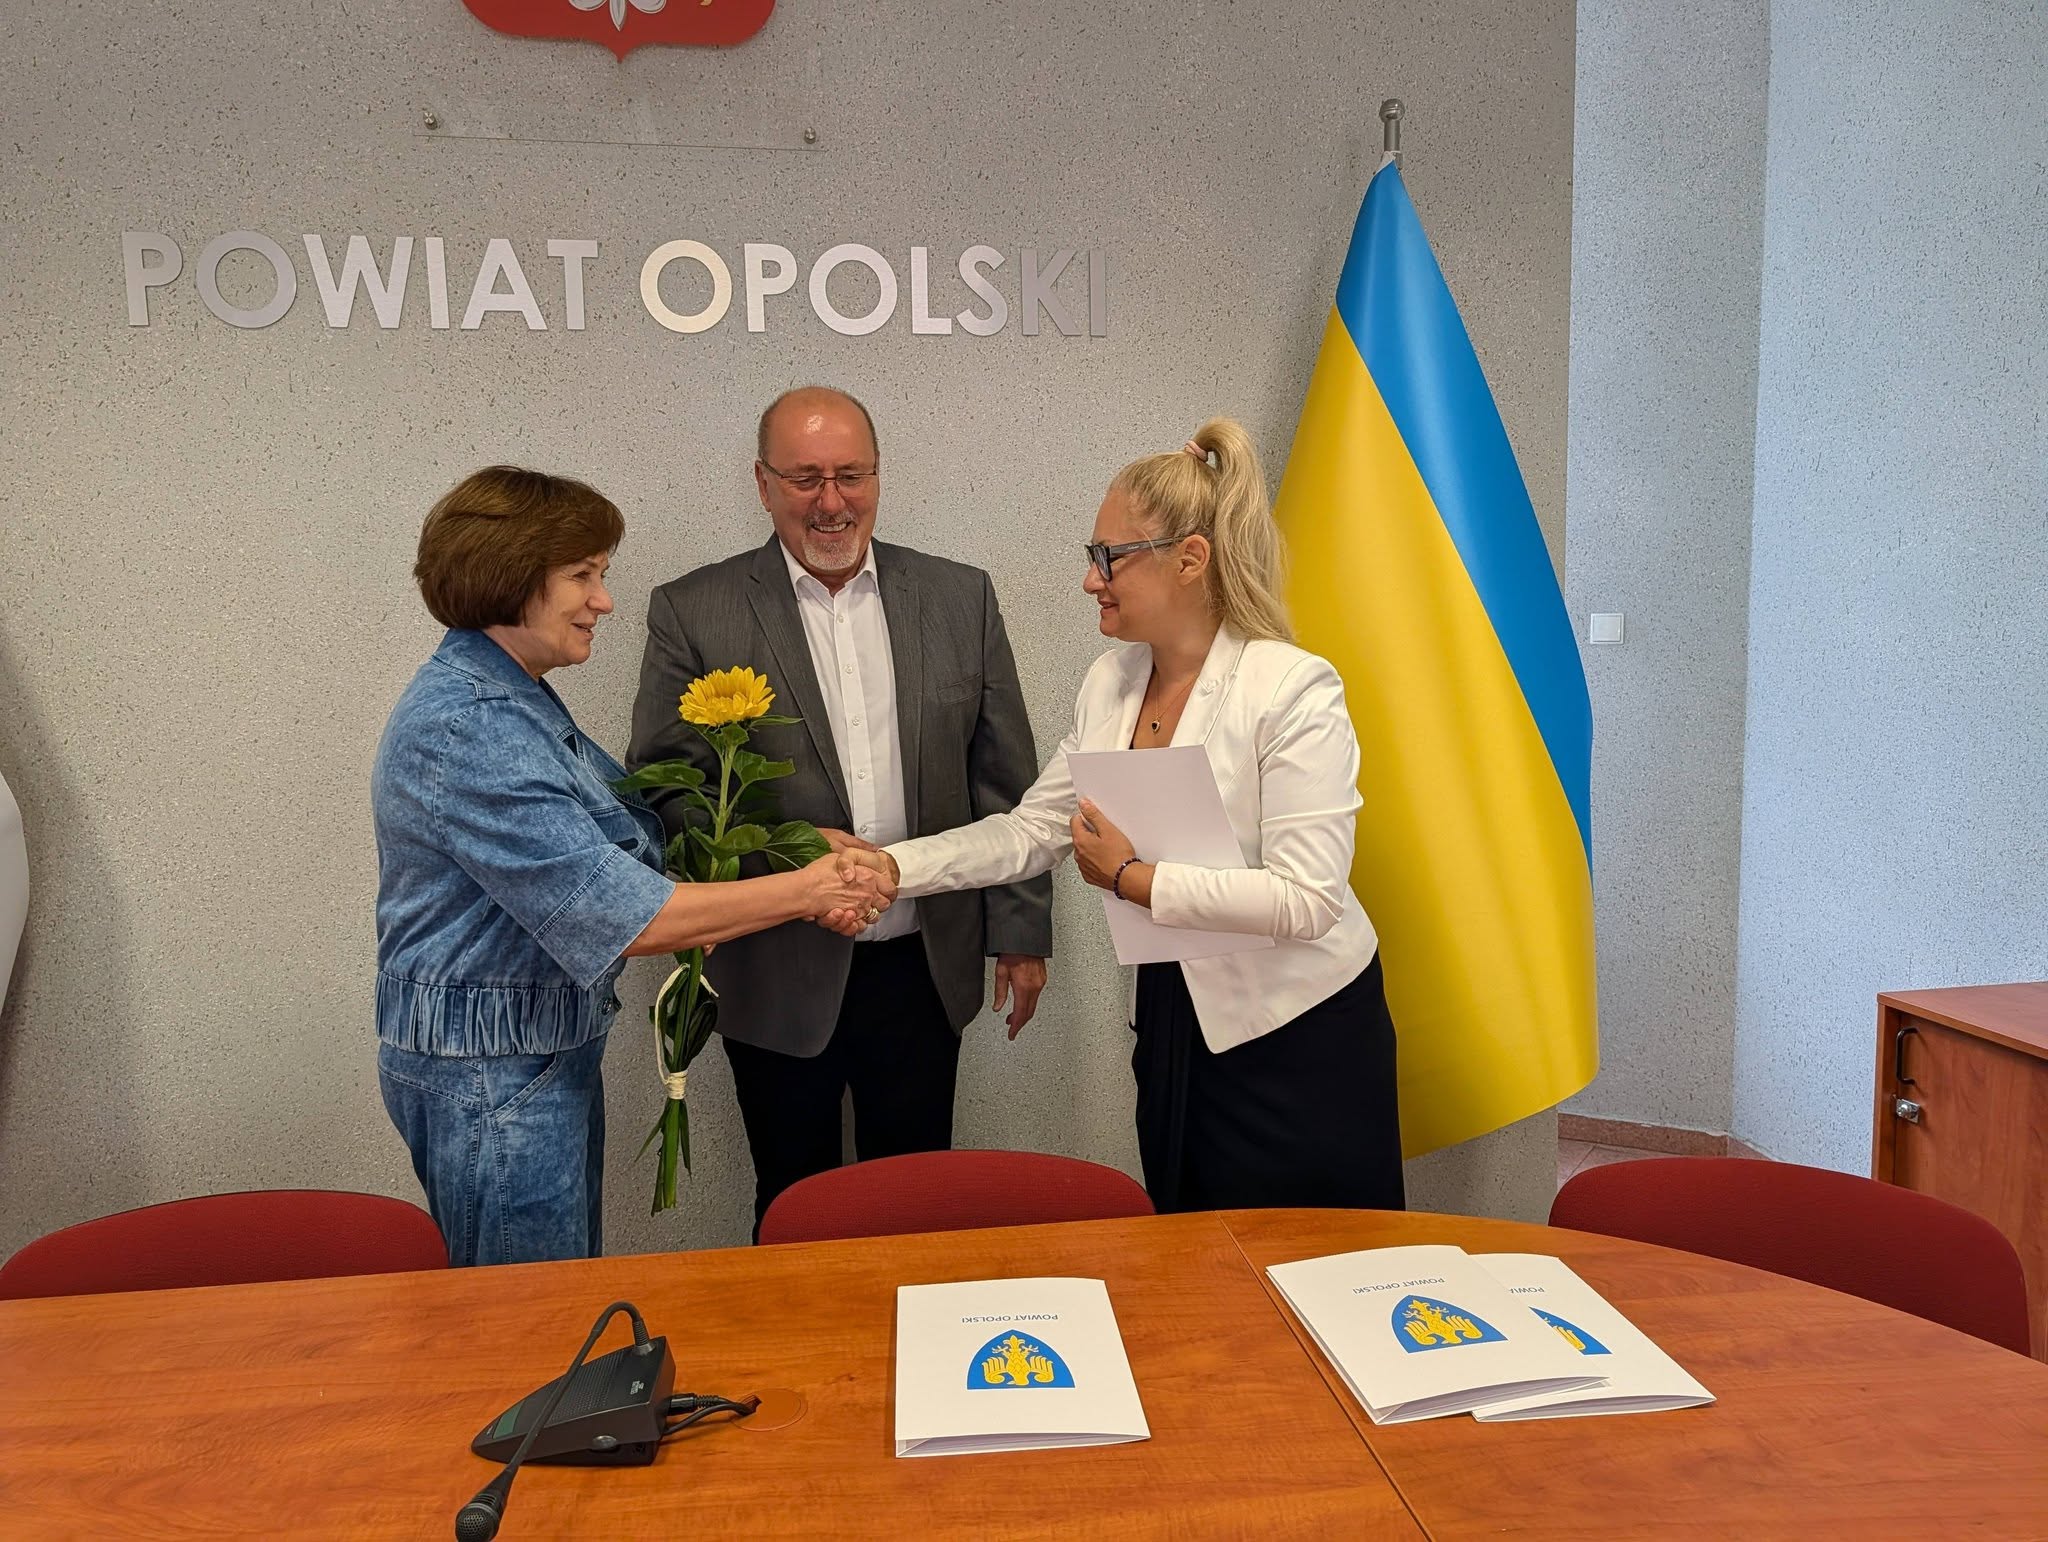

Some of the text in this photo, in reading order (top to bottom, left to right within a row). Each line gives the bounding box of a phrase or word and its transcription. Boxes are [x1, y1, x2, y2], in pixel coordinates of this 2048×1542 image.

[121, 230, 1108, 337] POWIAT OPOLSKI
[1352, 1277, 1446, 1295] POWIAT OPOLSKI
[1508, 1286, 1545, 1294] POWIA
[961, 1313, 1059, 1323] POWIAT OPOLSKI
